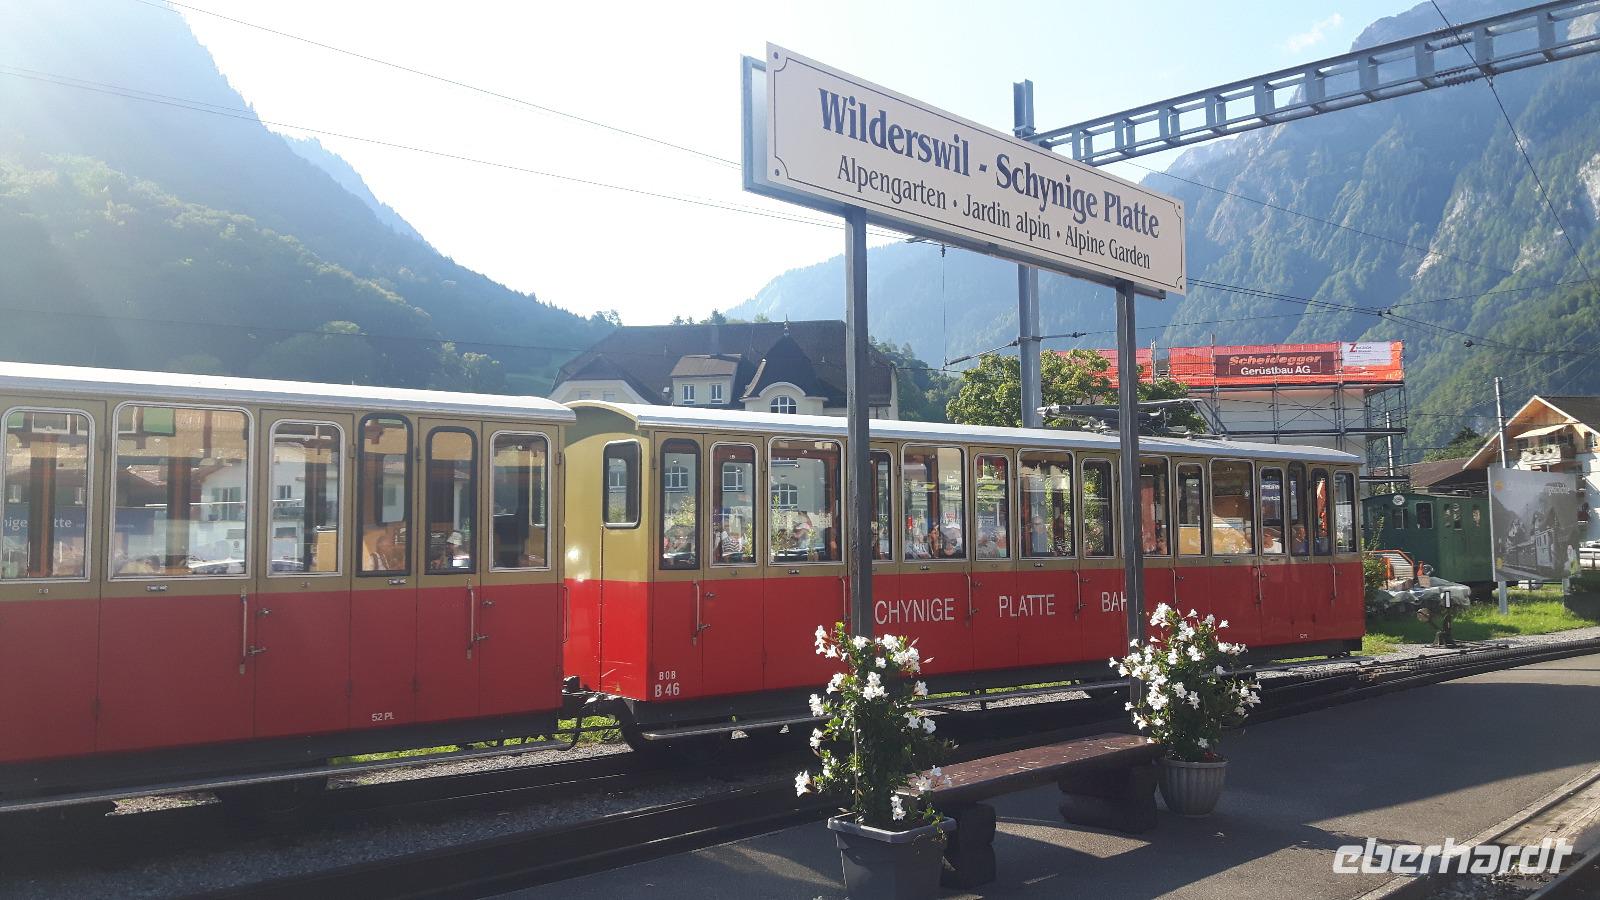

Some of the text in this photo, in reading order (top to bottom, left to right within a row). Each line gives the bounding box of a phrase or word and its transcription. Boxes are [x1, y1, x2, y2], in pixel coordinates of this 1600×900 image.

[818, 88, 970, 177] Wilderswil
[996, 153, 1098, 225] Schynige
[1103, 190, 1159, 239] Platte
[837, 154, 1151, 270] Alpengarten Jardin alpin Alpine Garden
[1229, 354, 1322, 366] Scheidegger
[1240, 365, 1311, 376] Gerüstbau AG
[874, 591, 1128, 625] CHYNIGE PLATTE BAH
[654, 682, 680, 698] B 46
[371, 712, 383, 722] 52
